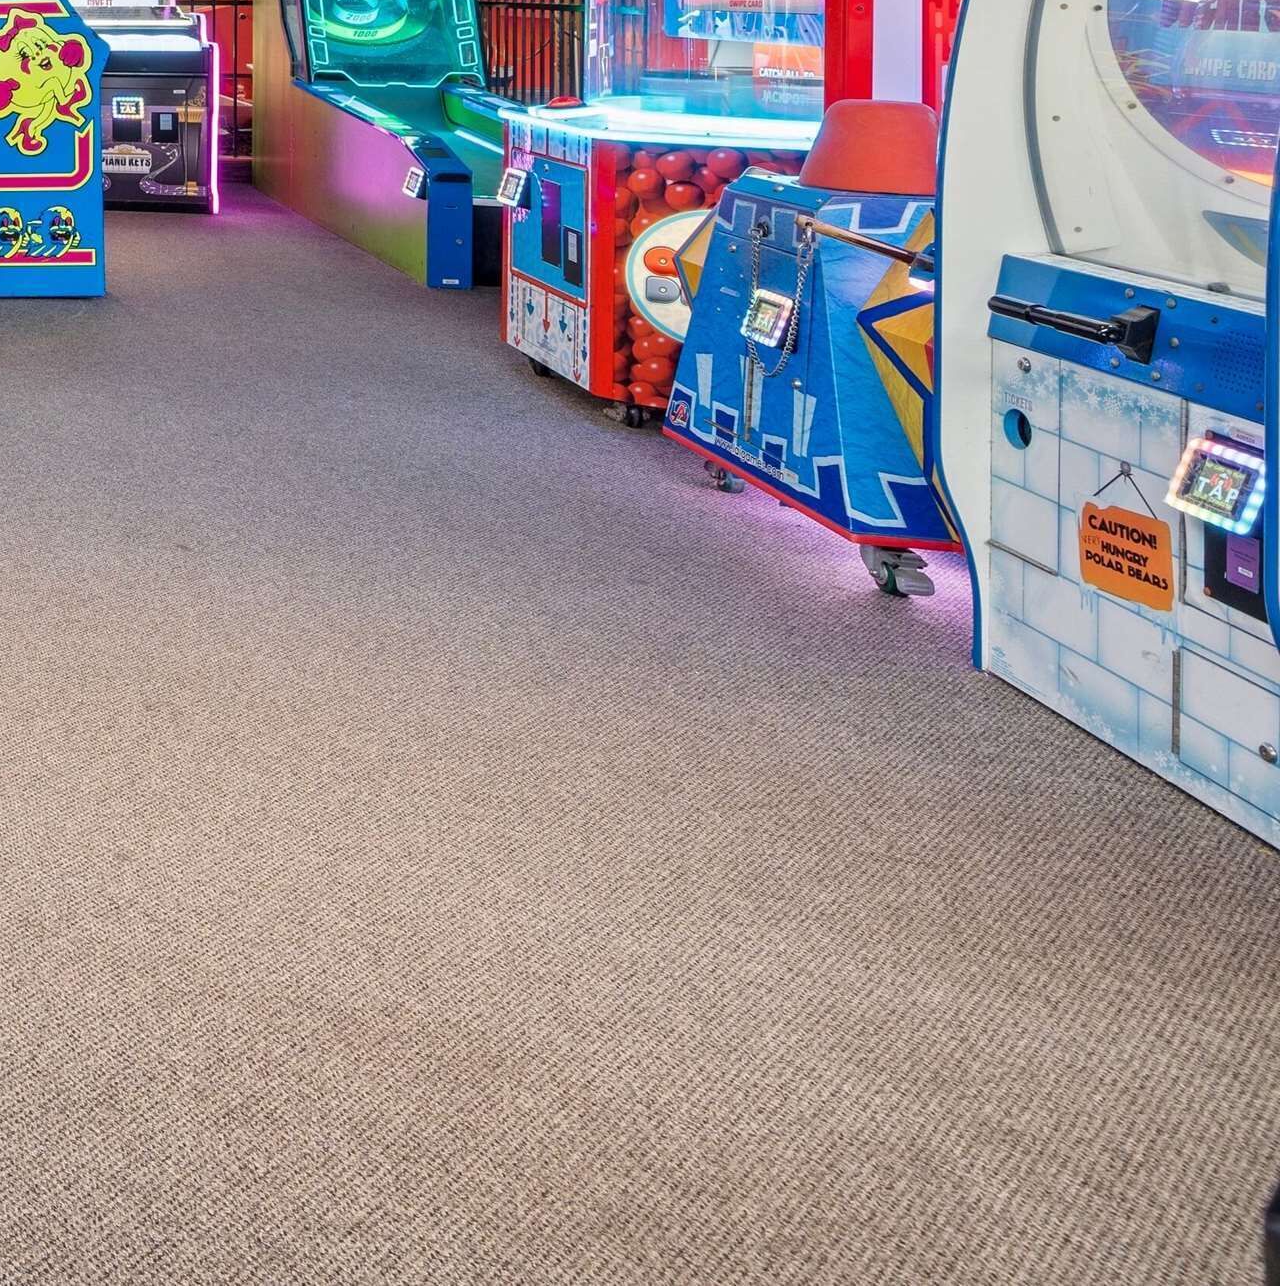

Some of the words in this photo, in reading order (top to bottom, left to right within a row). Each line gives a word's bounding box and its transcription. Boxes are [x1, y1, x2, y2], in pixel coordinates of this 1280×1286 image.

[353, 29, 379, 38] 1000
[759, 68, 780, 78] CATCH
[1237, 59, 1277, 81] CARD
[121, 105, 137, 114] TAP
[129, 158, 151, 167] KEYS
[1004, 391, 1033, 413] TICKETS
[1197, 476, 1240, 504] TAP
[1088, 514, 1158, 550] CAUTION!
[1101, 540, 1149, 568] HUNGRY
[1085, 549, 1125, 575] POLAR
[1128, 566, 1169, 591] BEARS
